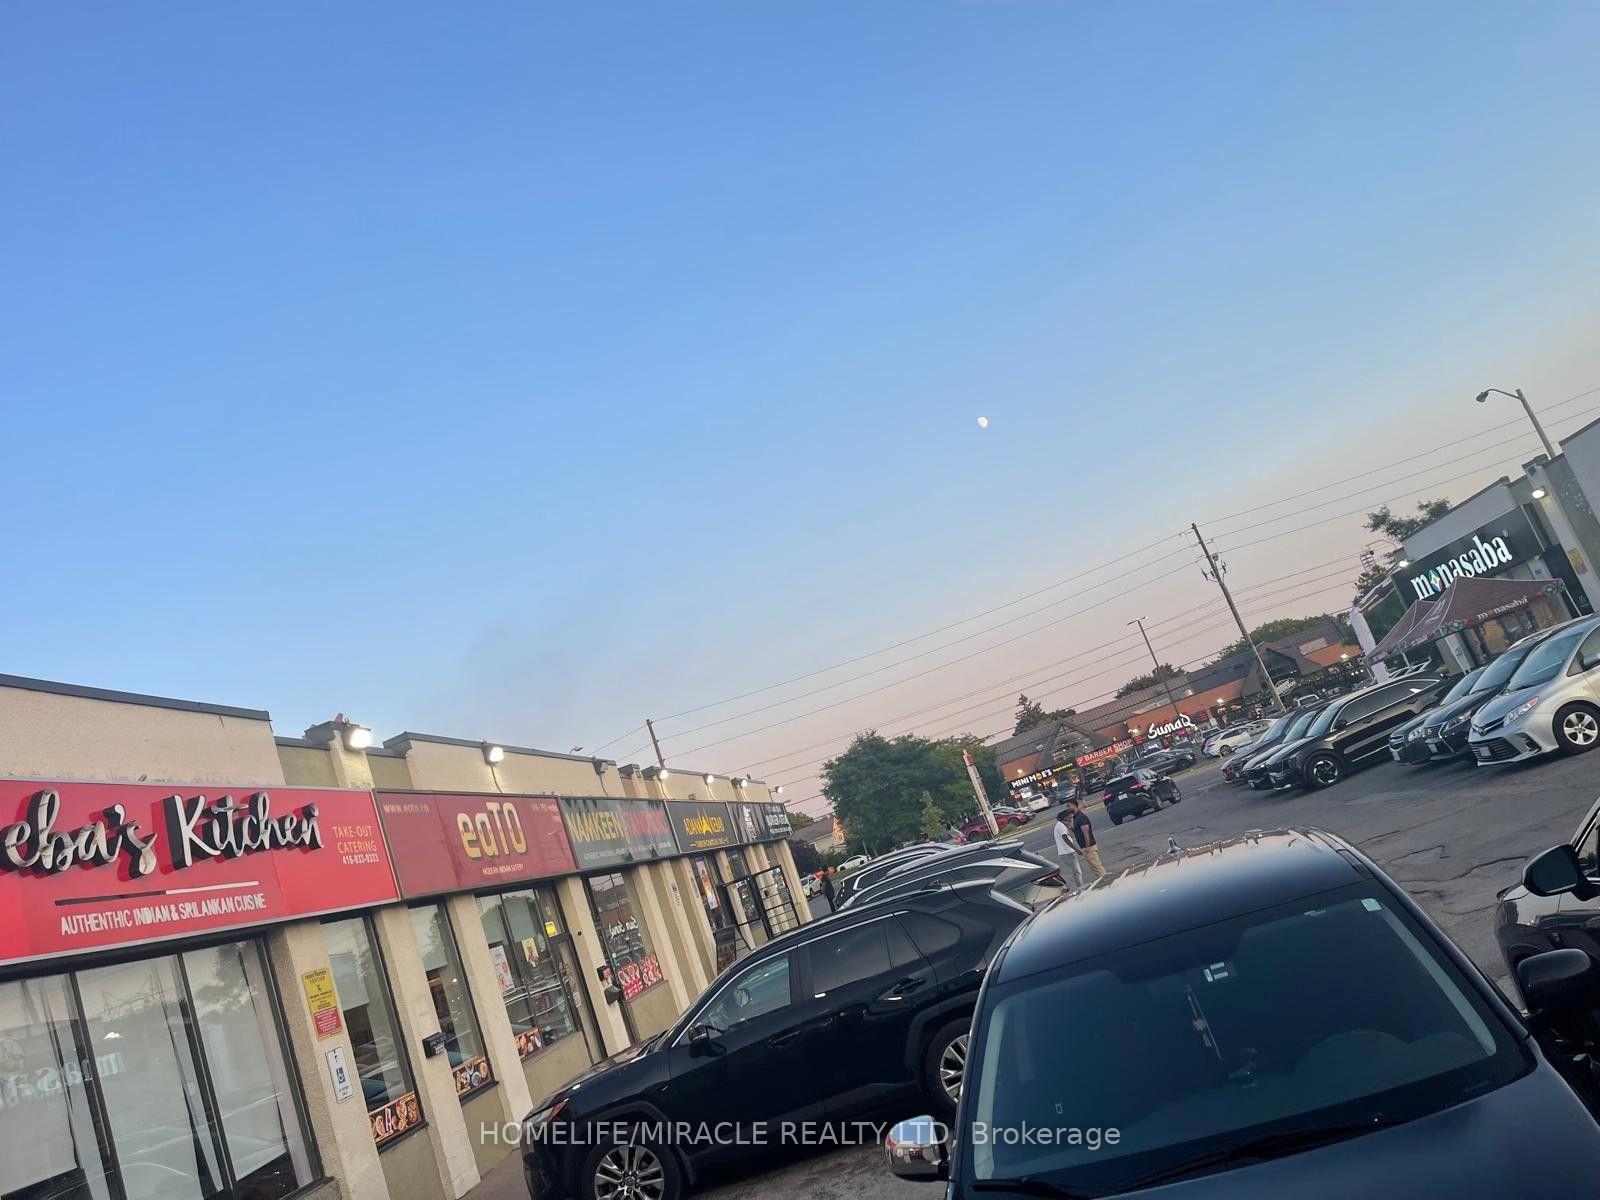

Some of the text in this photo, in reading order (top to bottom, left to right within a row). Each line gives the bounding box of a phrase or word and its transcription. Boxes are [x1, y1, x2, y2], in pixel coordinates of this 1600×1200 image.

[1084, 747, 1113, 761] BARBER
[1113, 739, 1134, 754] SHOP
[1011, 777, 1030, 788] MINI
[168, 791, 325, 867] Kitchen
[332, 825, 373, 839] TAKE-OUT
[565, 811, 624, 843] NAMKEEN
[337, 840, 378, 854] CATERING
[133, 902, 171, 926] INDIAN
[169, 904, 180, 921] &
